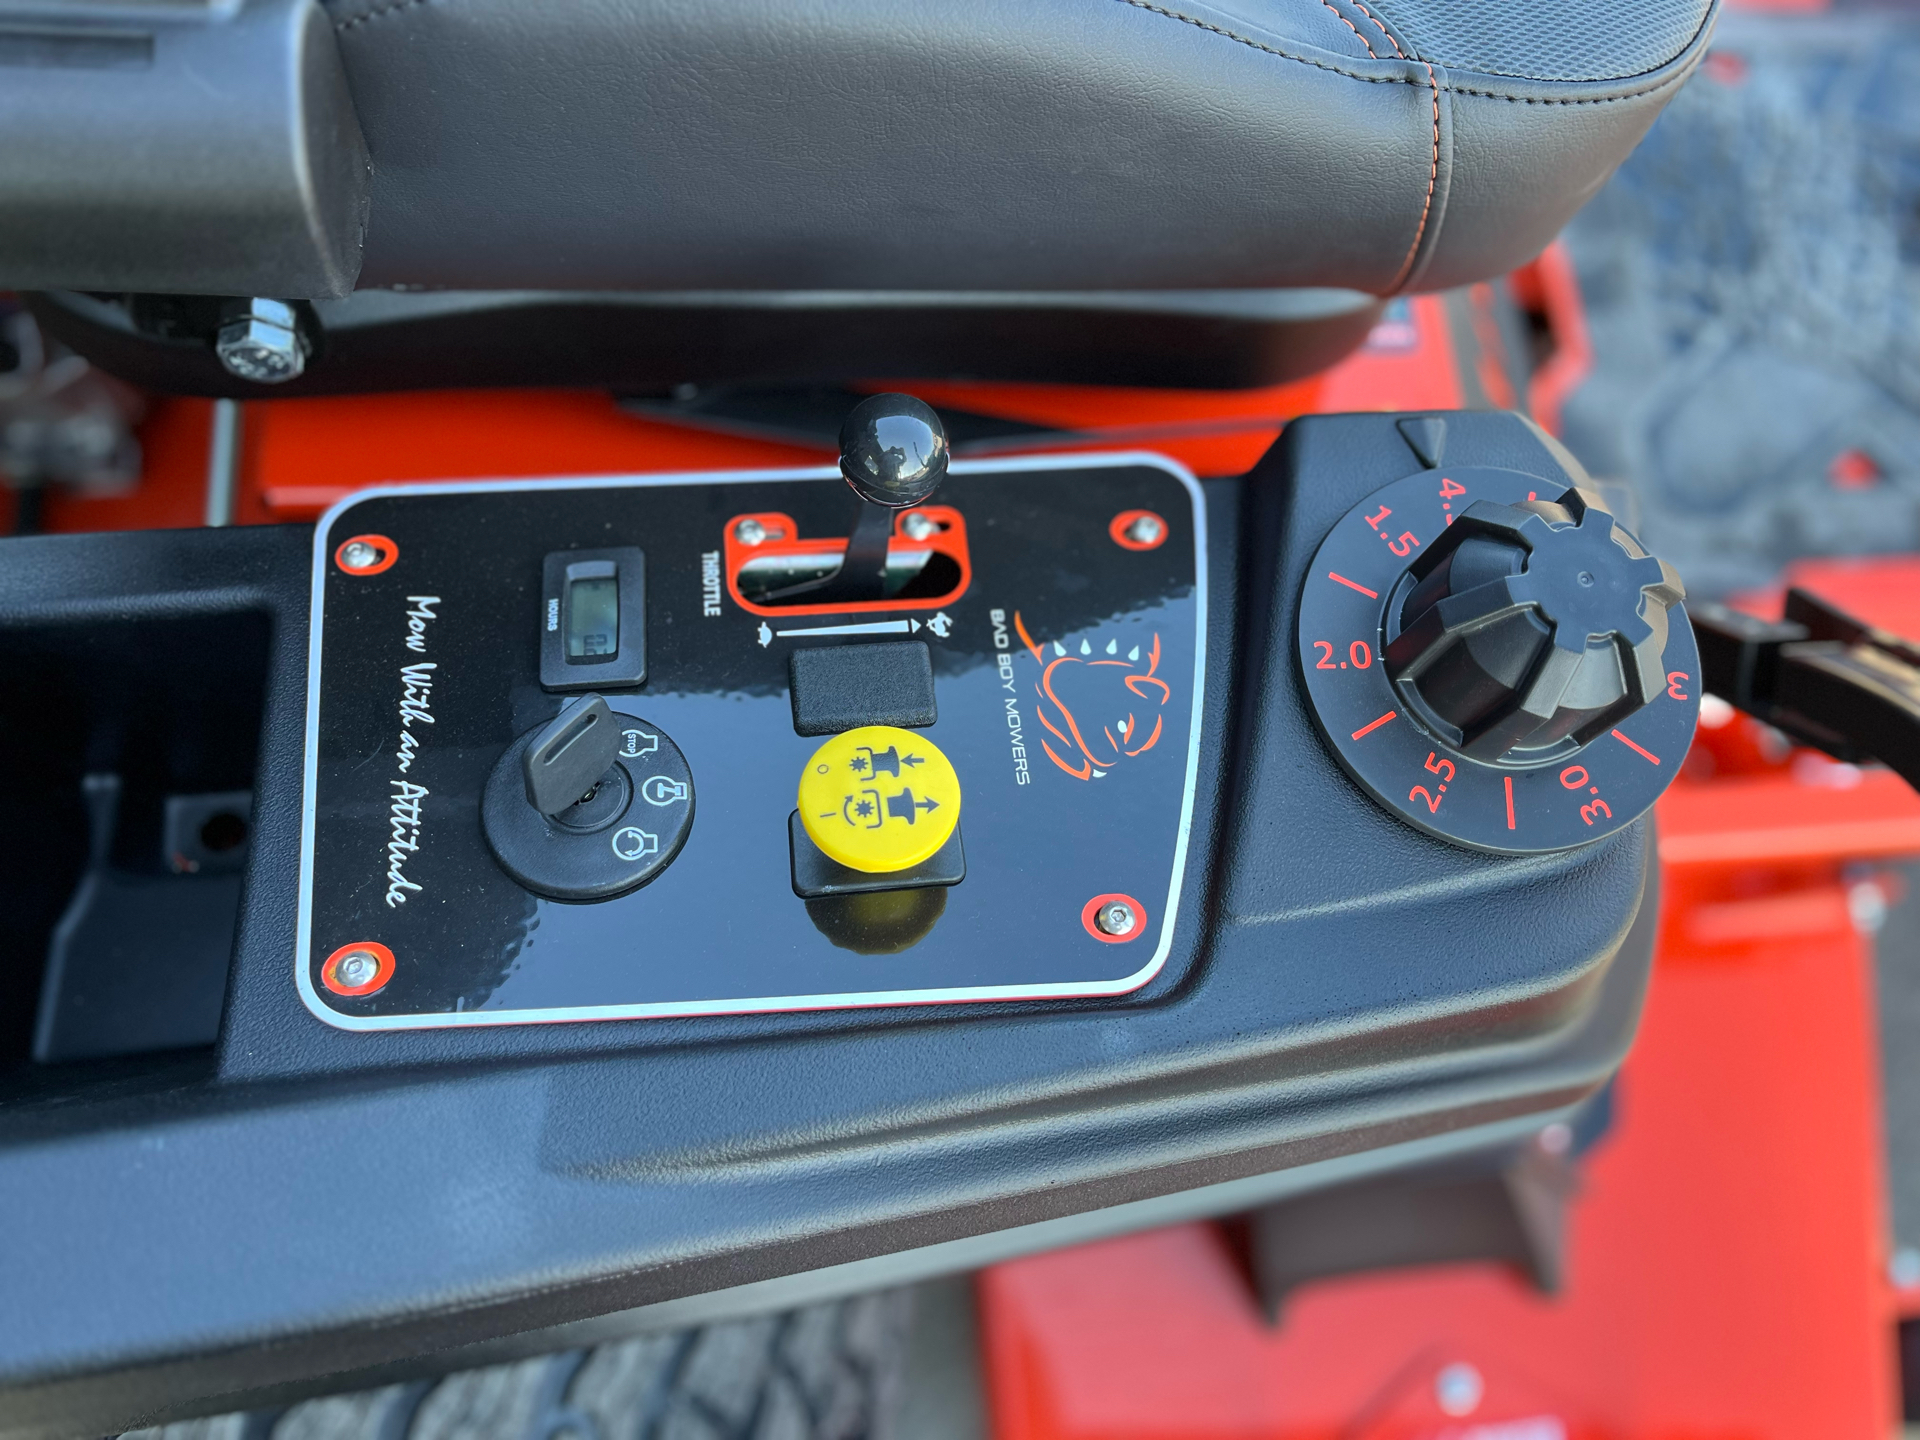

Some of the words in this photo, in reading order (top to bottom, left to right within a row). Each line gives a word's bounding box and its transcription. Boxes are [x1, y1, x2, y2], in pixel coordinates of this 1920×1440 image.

[1439, 478, 1466, 526] 4.
[1364, 504, 1420, 558] 1.5
[702, 550, 721, 617] THROTTLE
[405, 595, 442, 653] Mow
[547, 598, 559, 632] HOURS
[990, 608, 1009, 649] BAD
[997, 652, 1016, 693] BOY
[1313, 640, 1372, 670] 2.0
[399, 662, 438, 727] With
[396, 729, 420, 774] an
[627, 733, 637, 753] STOP
[1004, 698, 1031, 786] MOWERS
[1408, 750, 1456, 813] 2.5
[1559, 764, 1613, 826] 3.0
[385, 780, 430, 908] Attitude
